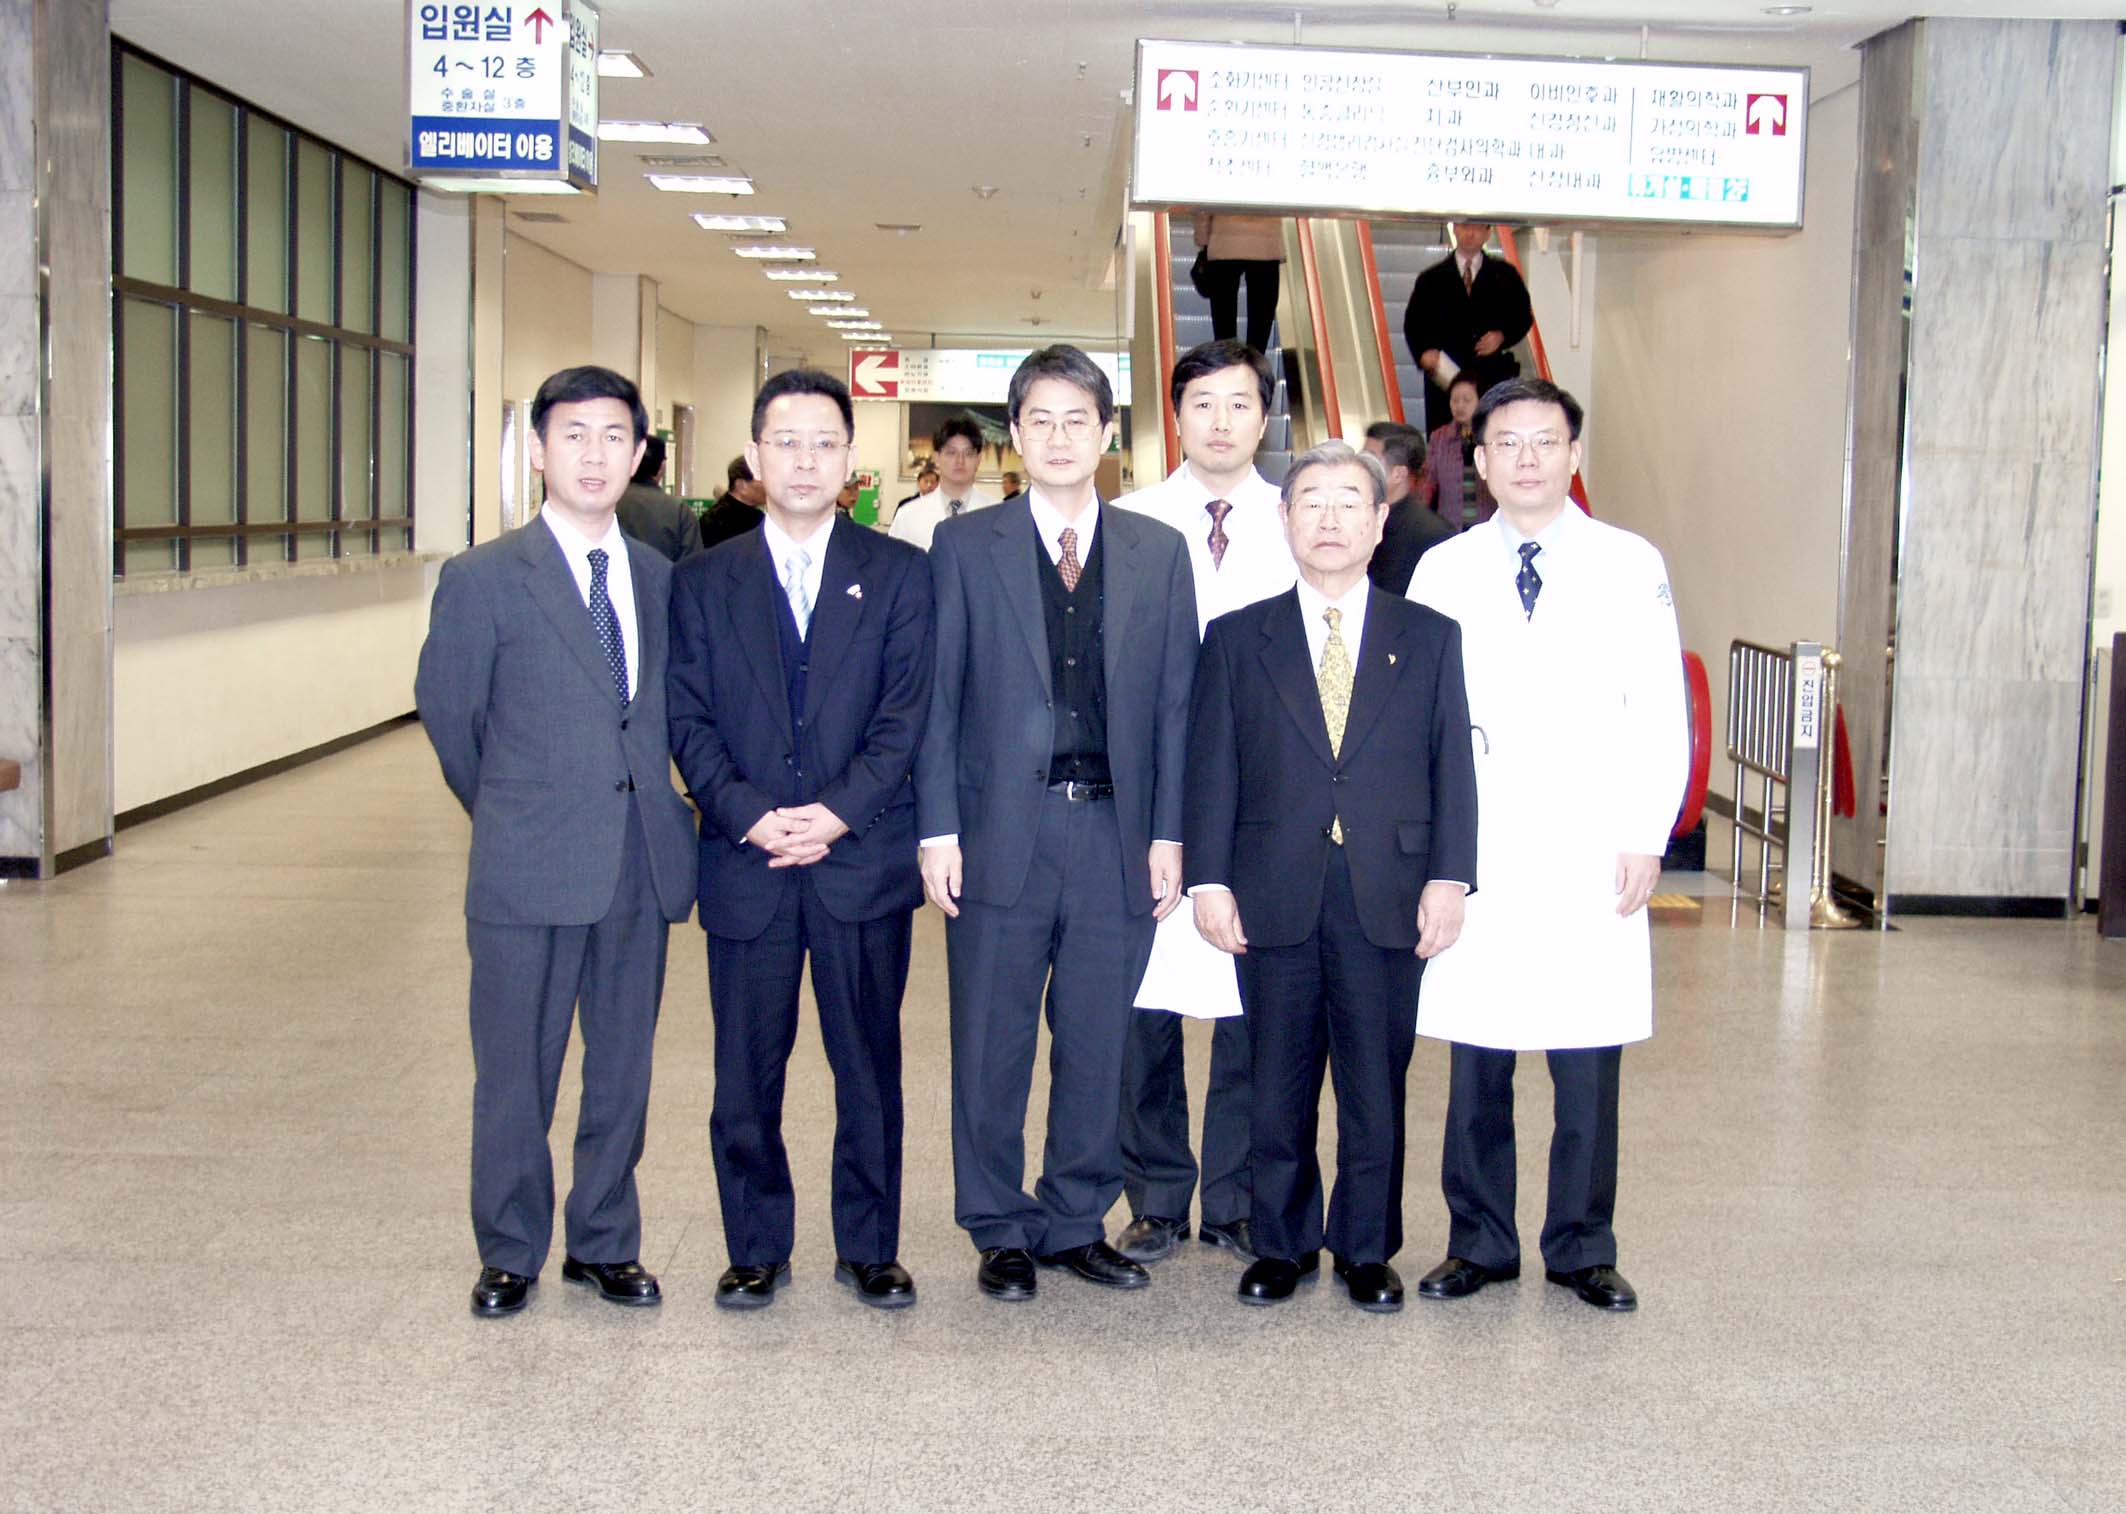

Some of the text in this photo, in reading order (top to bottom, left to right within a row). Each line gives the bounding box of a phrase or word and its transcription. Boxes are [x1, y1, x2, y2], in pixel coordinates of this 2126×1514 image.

[420, 4, 512, 41] 입원실
[1427, 79, 1499, 100] 산부인과
[1530, 83, 1617, 104] 이비인후과
[1651, 89, 1737, 110] 재활의학과
[1651, 118, 1736, 139] 가정의학과
[419, 130, 512, 160] 엘리베이터
[515, 133, 553, 161] 이용
[1801, 679, 1814, 738] 진입금지
